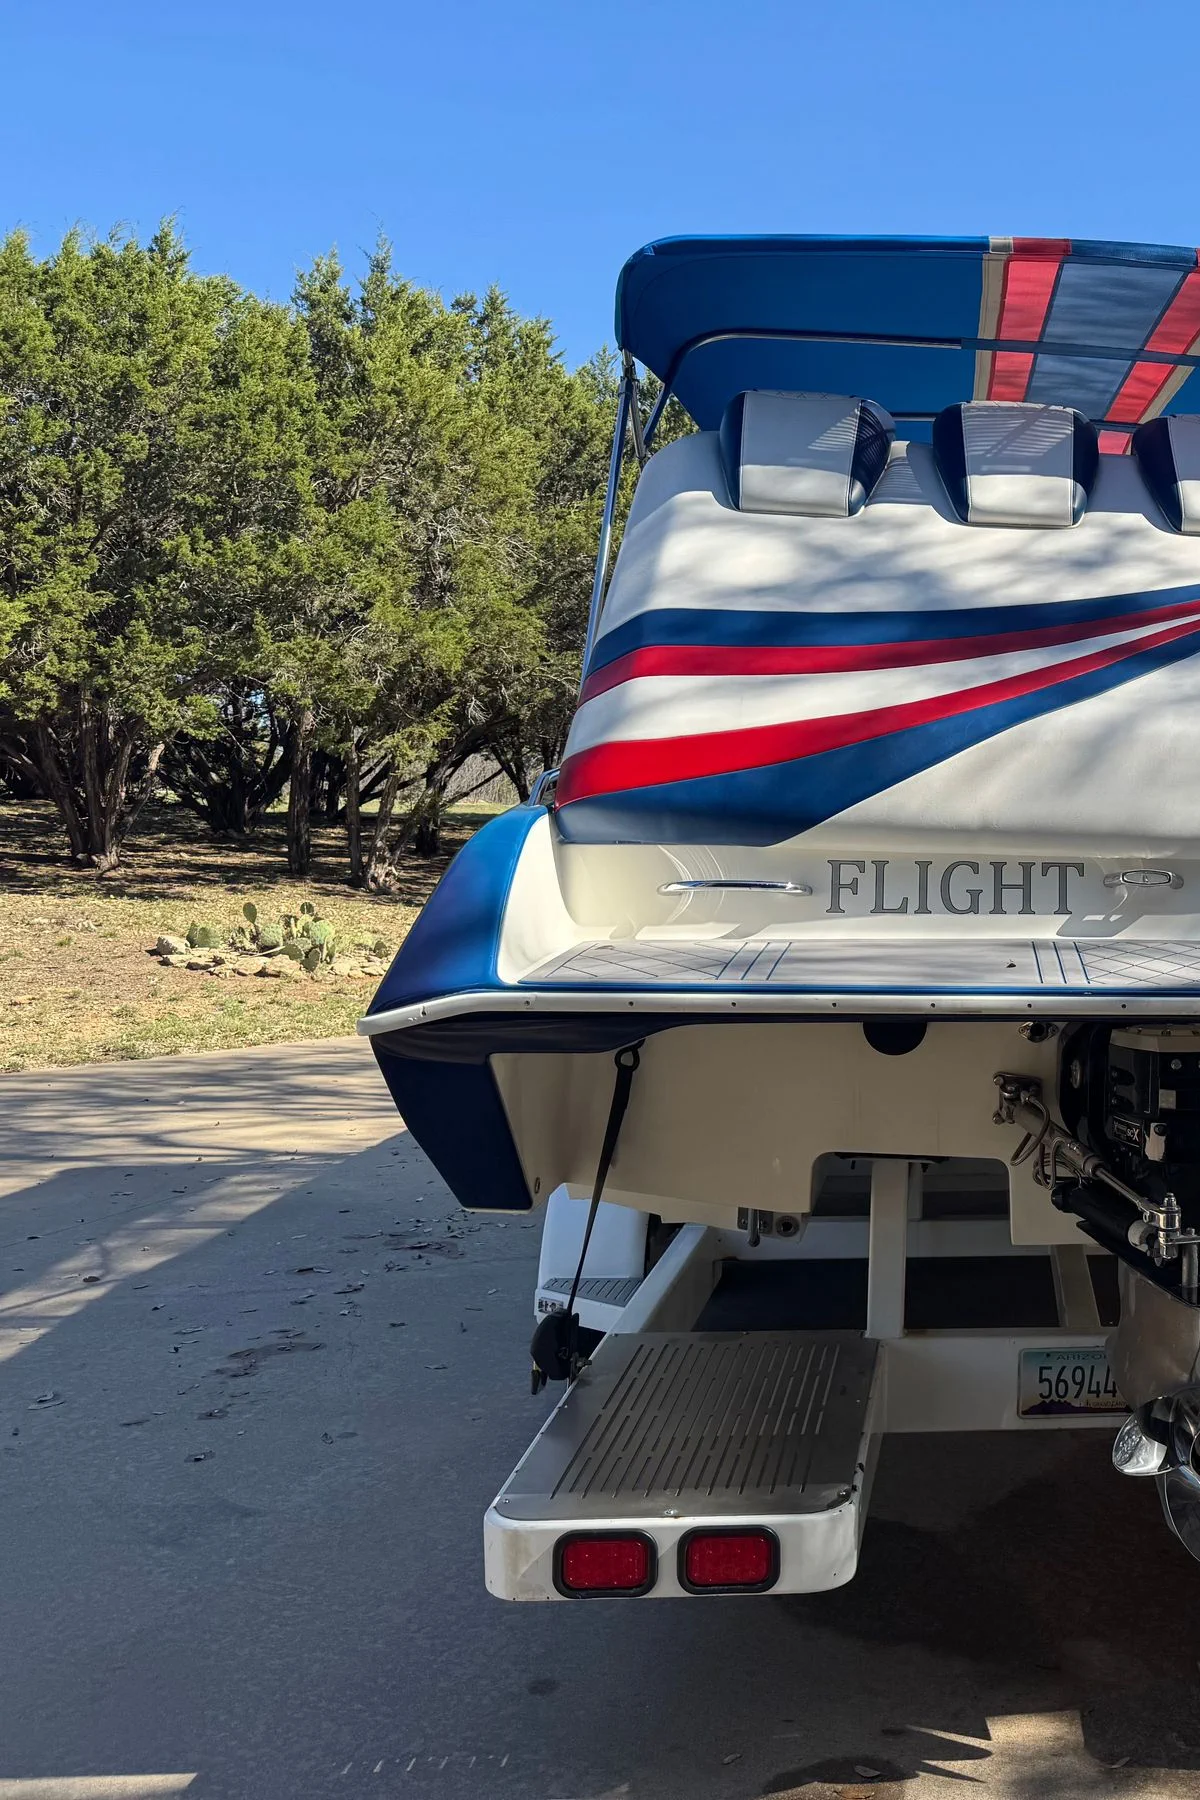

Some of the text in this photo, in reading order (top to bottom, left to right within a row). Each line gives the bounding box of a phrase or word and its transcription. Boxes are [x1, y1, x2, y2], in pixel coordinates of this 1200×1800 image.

[826, 859, 1084, 914] FLIGHT
[1056, 1352, 1107, 1361] ARIZO
[1038, 1365, 1118, 1399] 56944
